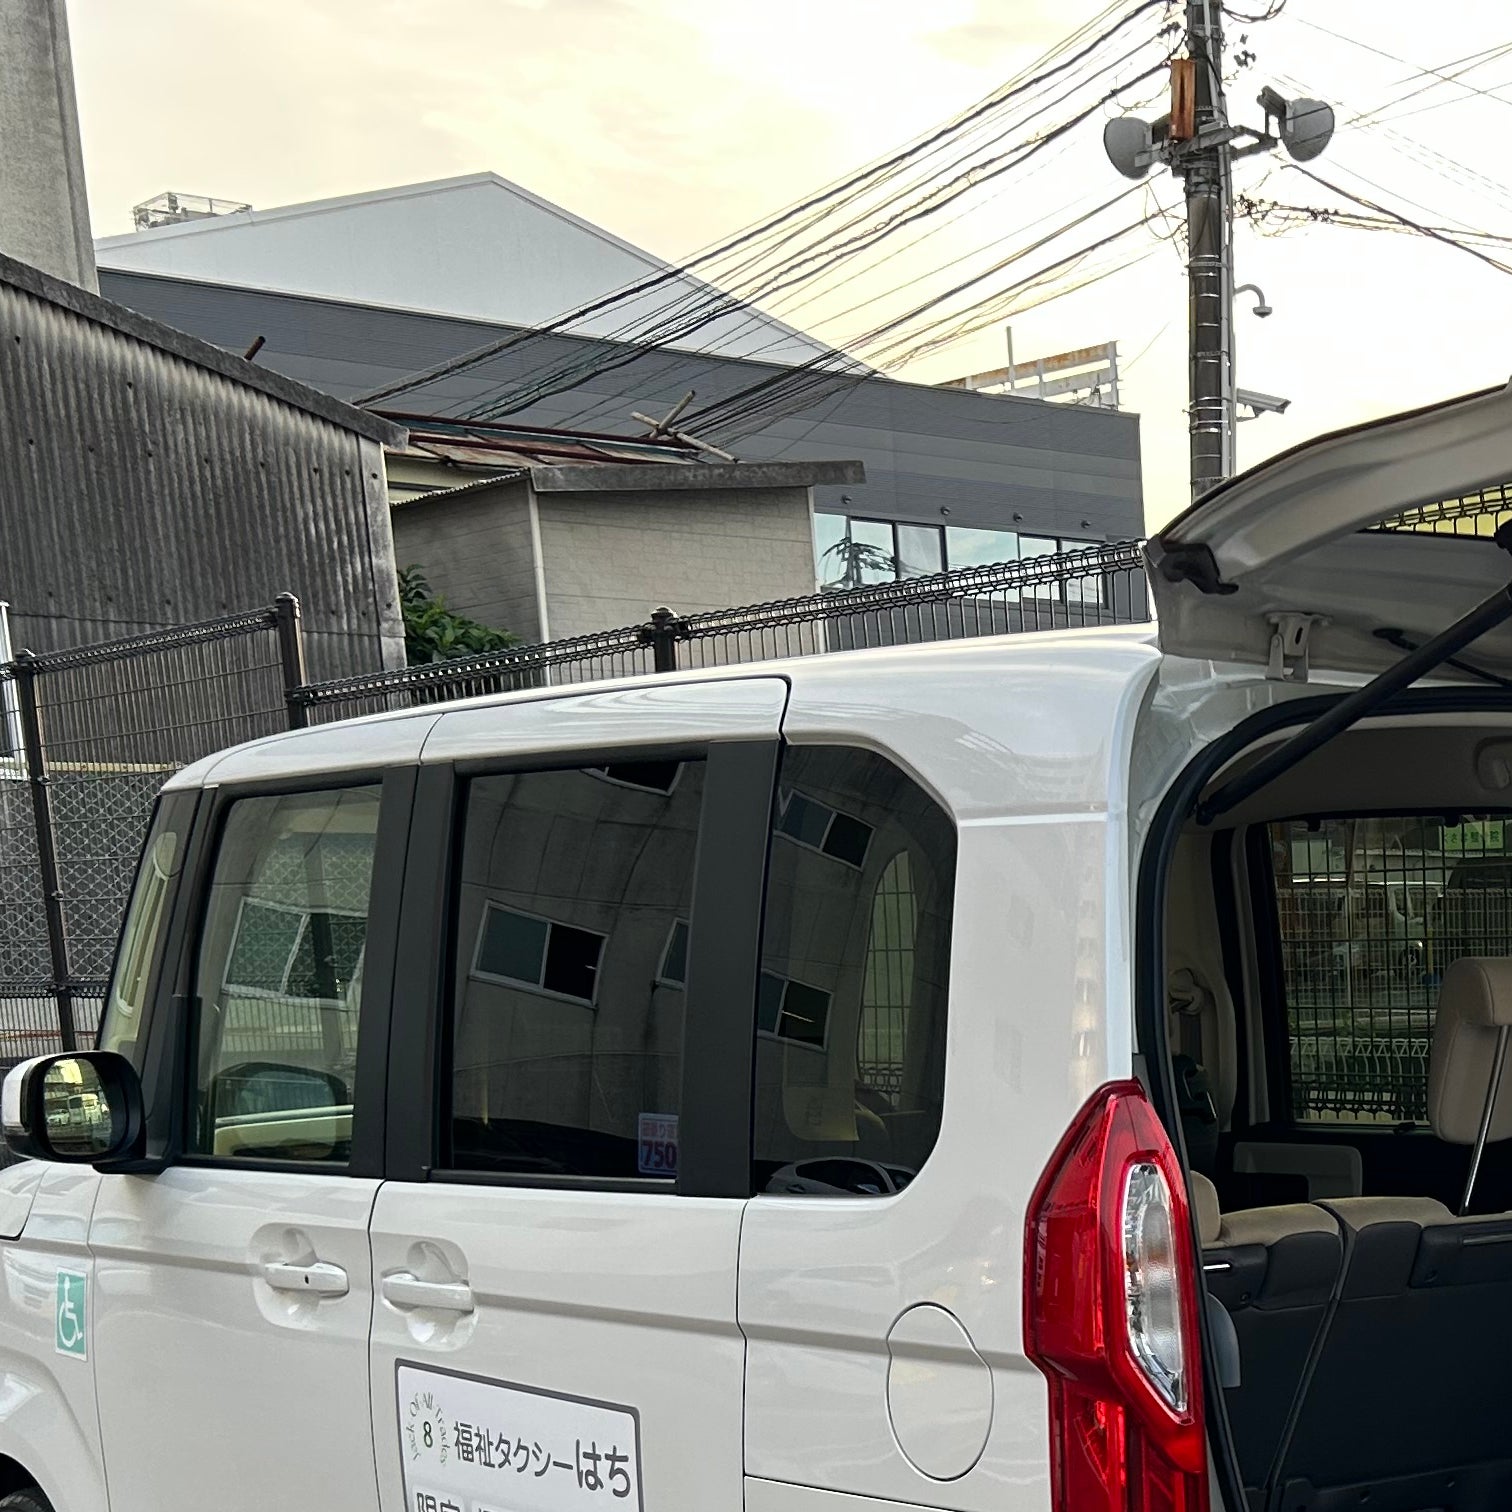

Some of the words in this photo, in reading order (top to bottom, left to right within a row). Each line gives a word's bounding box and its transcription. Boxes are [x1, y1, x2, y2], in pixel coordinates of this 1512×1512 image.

[641, 1140, 677, 1170] 750
[423, 1420, 434, 1448] 8
[453, 1420, 631, 1498] 福祉タクシーはち
